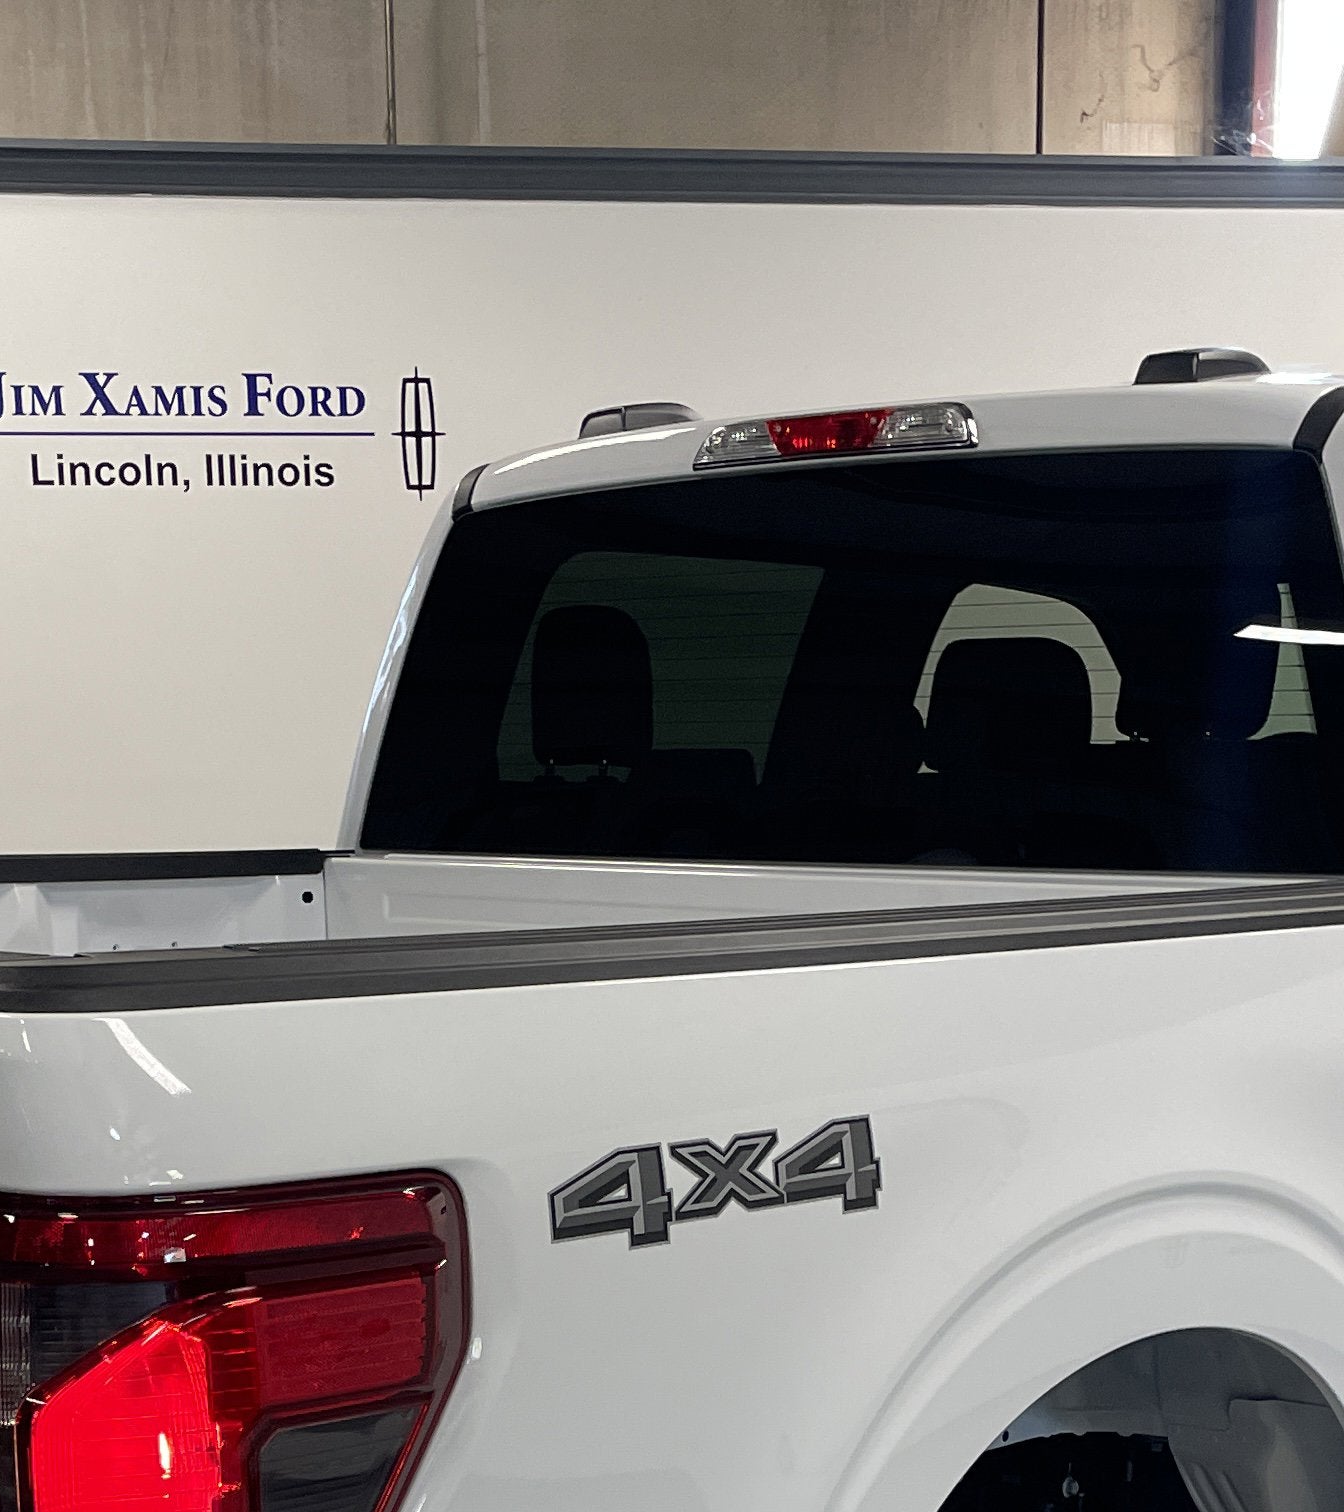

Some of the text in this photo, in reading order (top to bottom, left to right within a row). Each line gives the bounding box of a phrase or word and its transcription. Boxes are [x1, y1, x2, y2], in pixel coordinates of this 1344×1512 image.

[78, 371, 227, 417] XAMIS
[241, 372, 367, 418] FORD
[29, 453, 335, 493] Lincoln, Illinois
